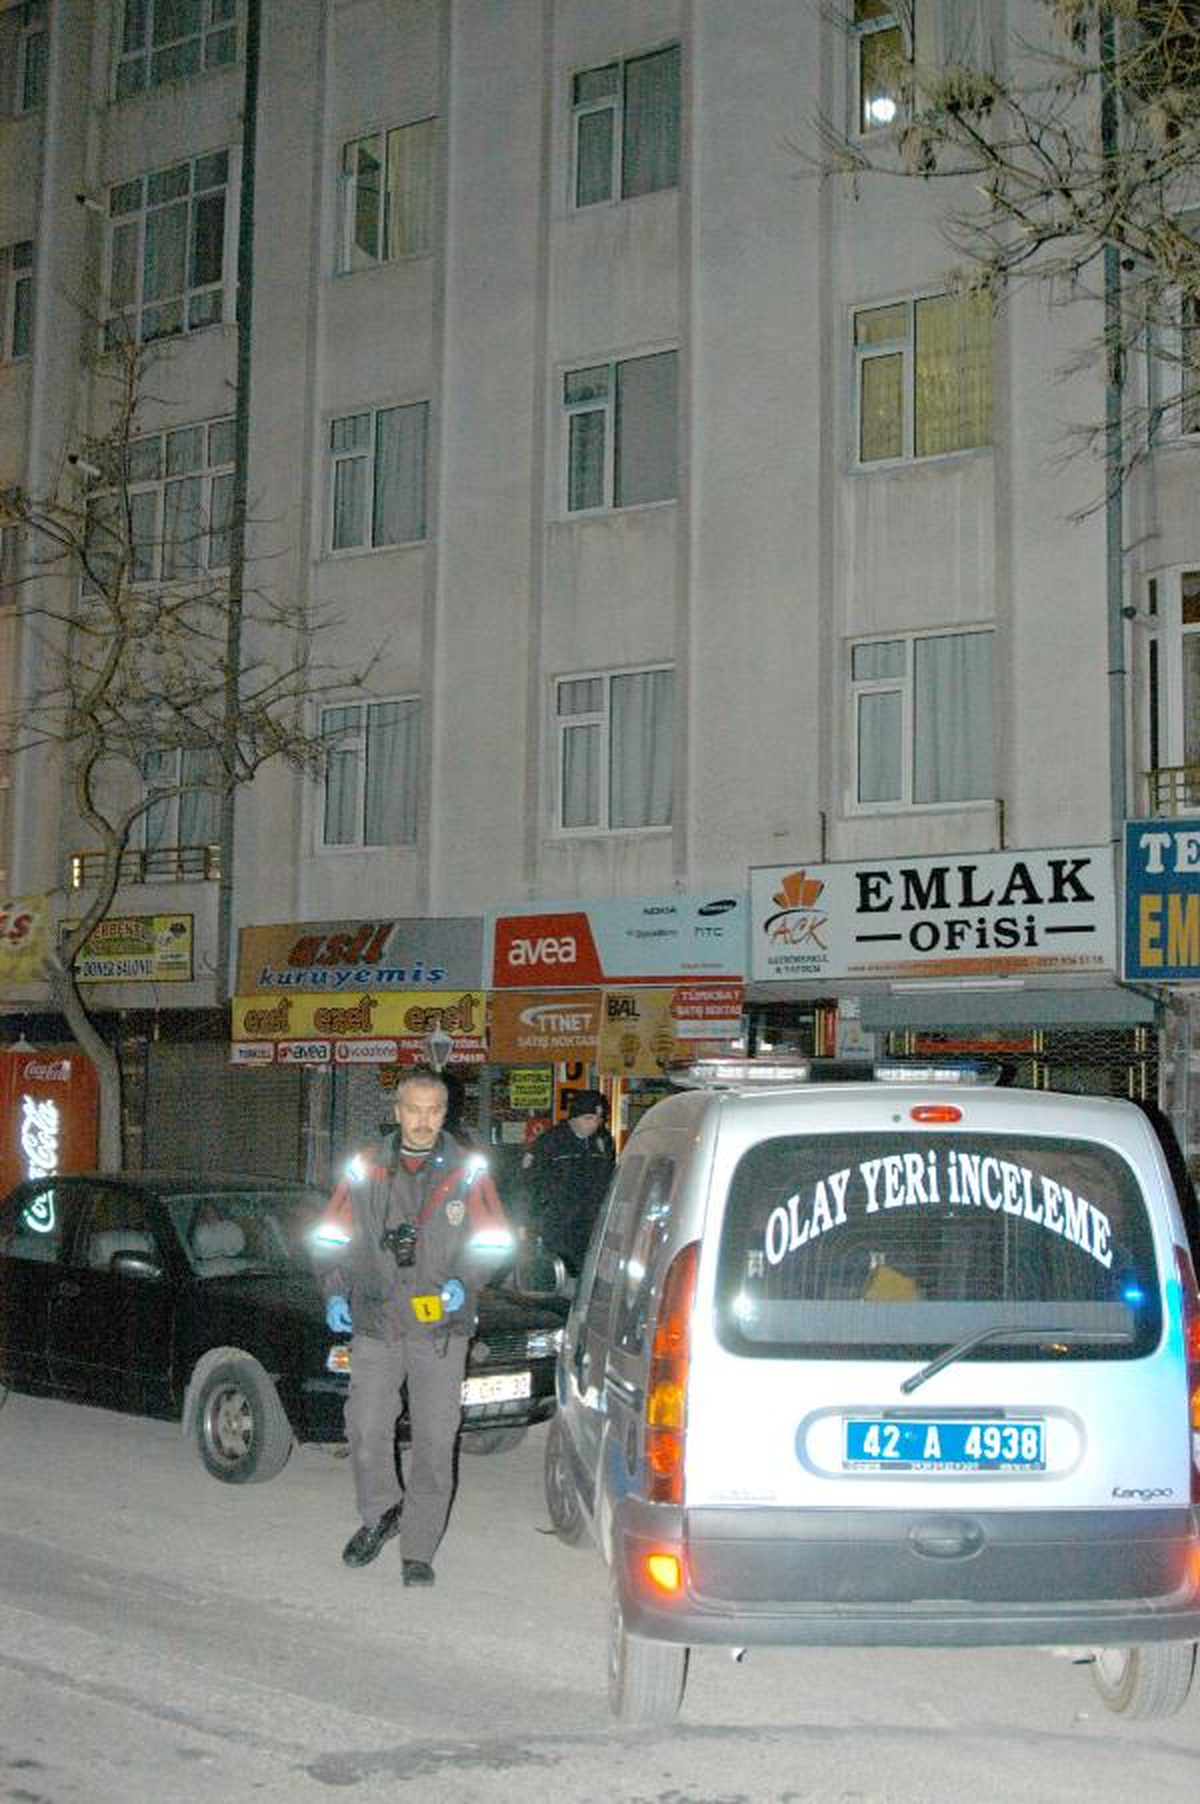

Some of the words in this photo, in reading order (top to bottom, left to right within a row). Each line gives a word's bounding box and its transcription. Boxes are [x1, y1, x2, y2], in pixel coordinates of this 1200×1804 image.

[1139, 832, 1200, 873] TE
[856, 858, 1094, 913] EMLAK
[909, 915, 1039, 952] OFiSi
[508, 937, 576, 965] avea
[540, 1013, 593, 1033] TTNET
[608, 1000, 640, 1017] BAL
[293, 1045, 326, 1059] avea
[765, 1169, 851, 1265] OLAY
[860, 1150, 940, 1213] YERi
[949, 1151, 1113, 1269] iNCELEME
[863, 1424, 901, 1458] 42
[923, 1426, 941, 1459] A
[965, 1426, 1039, 1460] 4938
[1111, 1487, 1174, 1500] Kangoo
